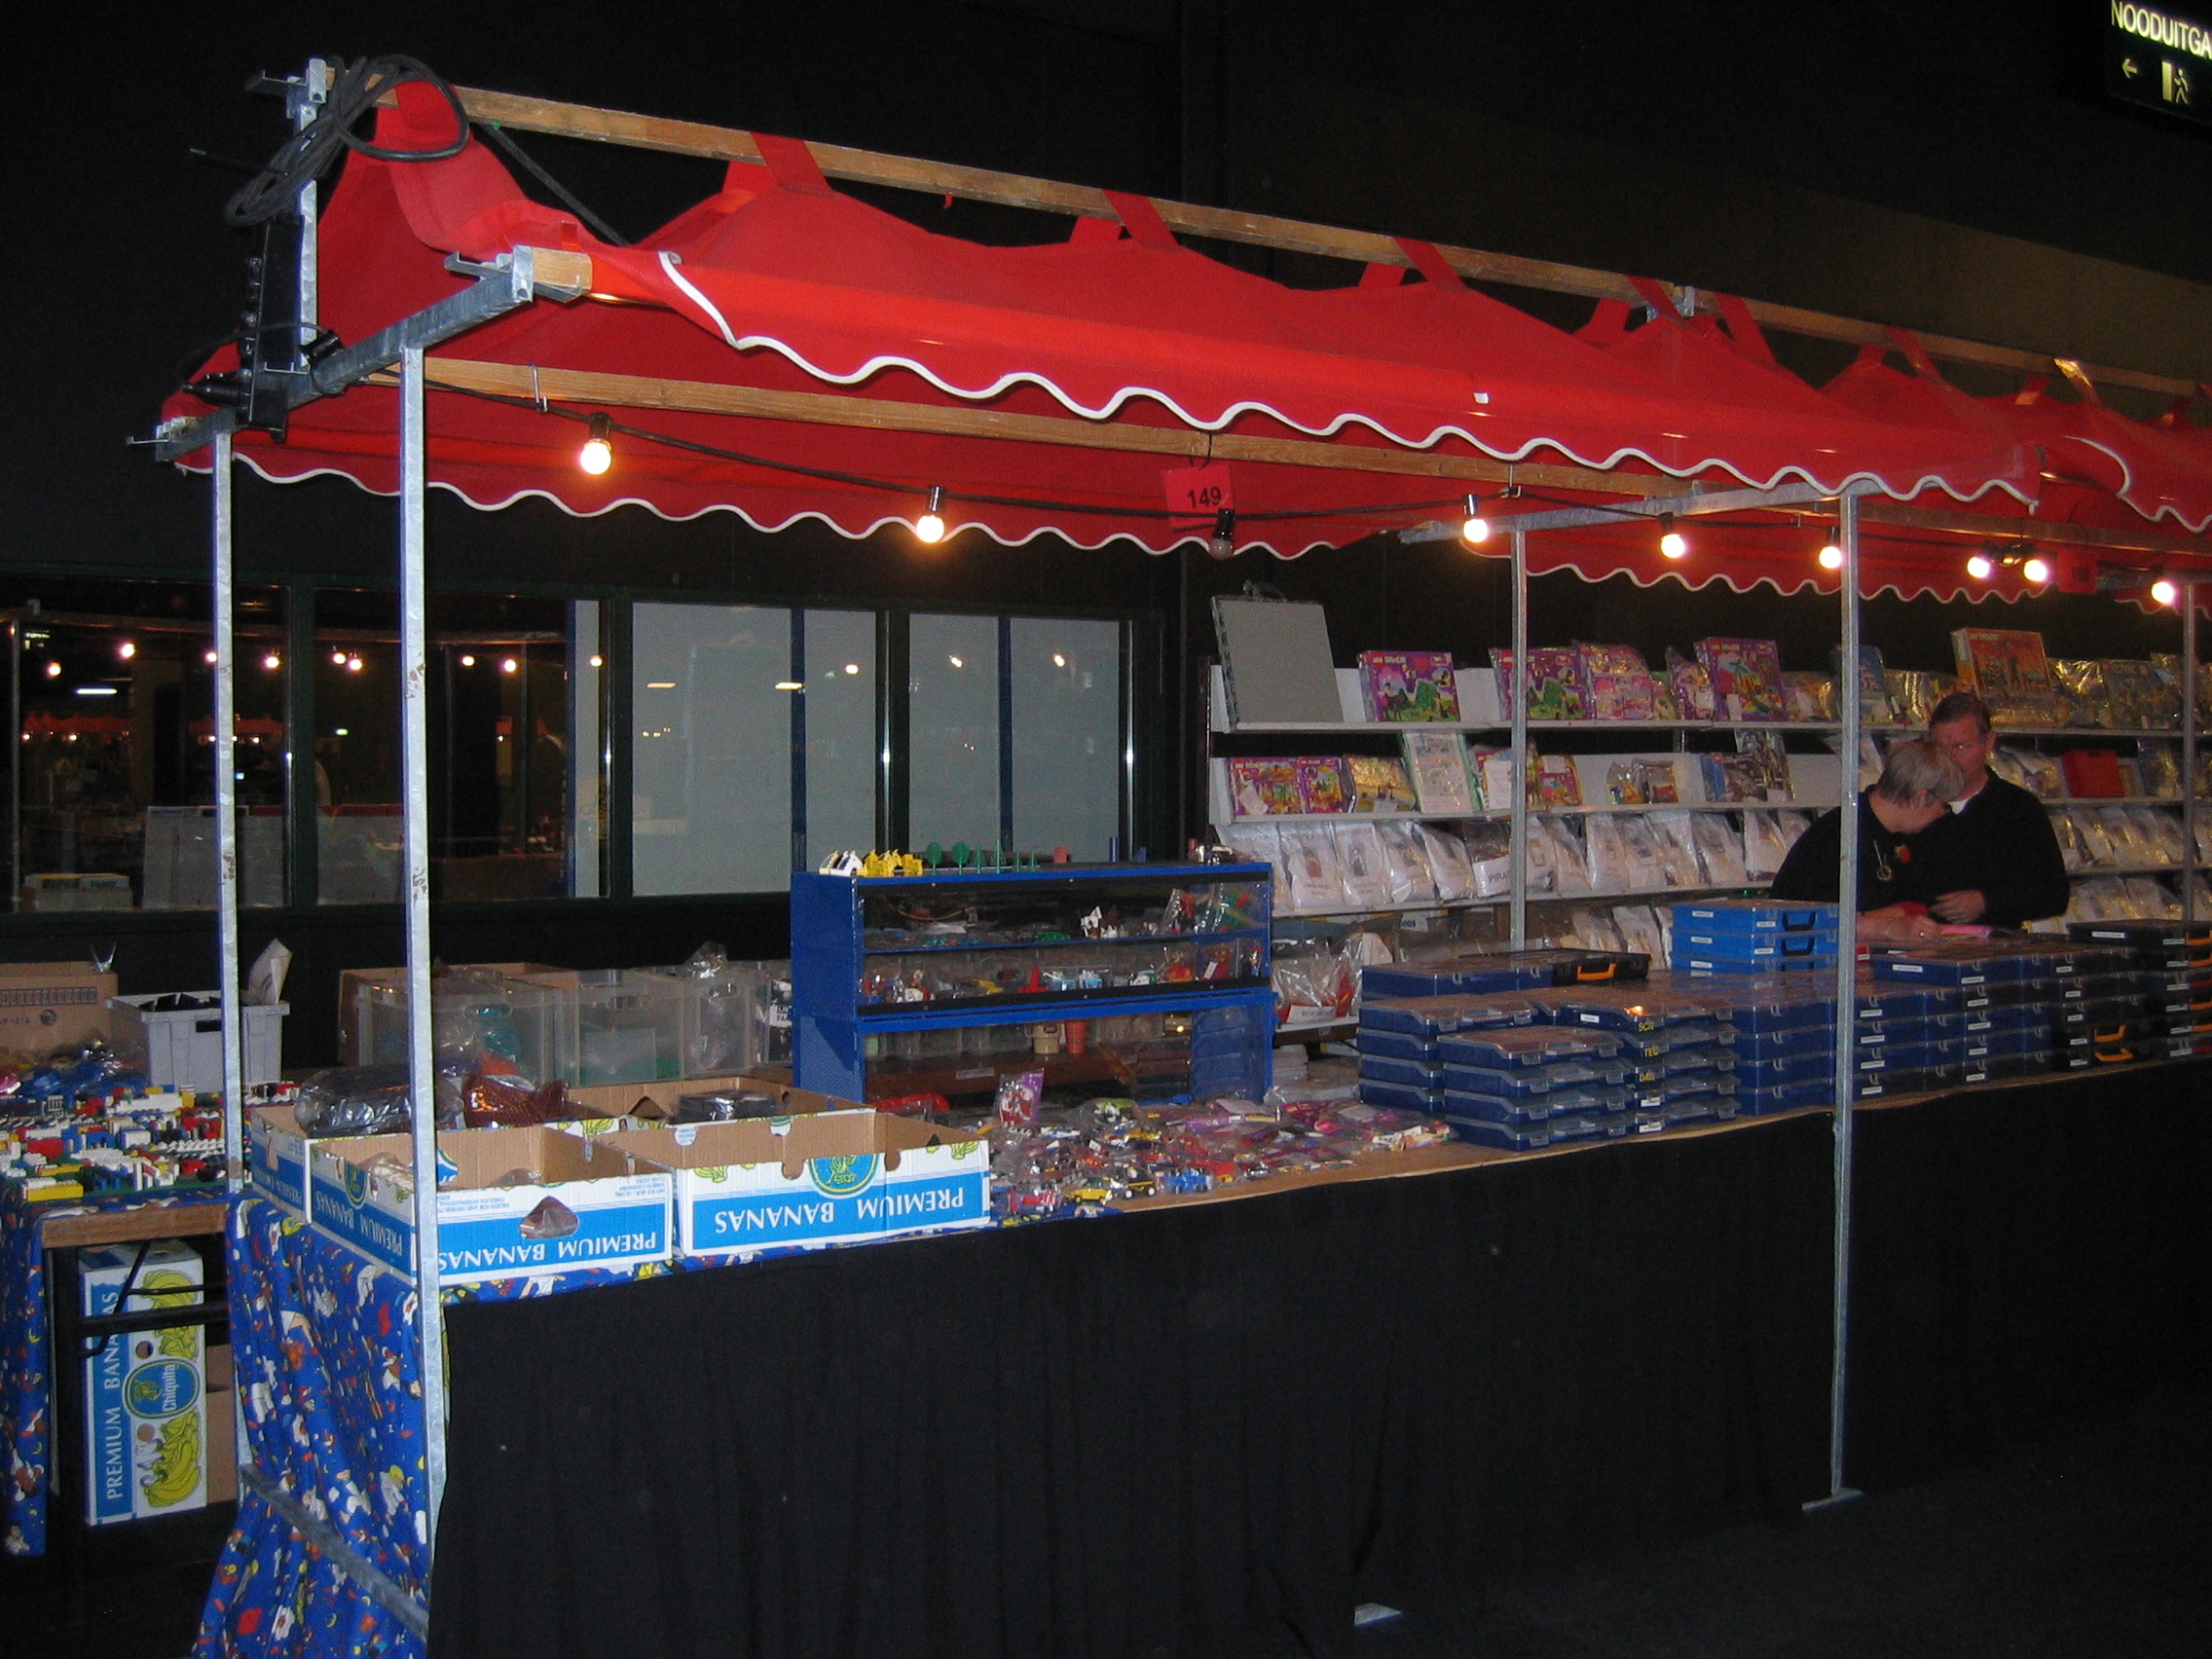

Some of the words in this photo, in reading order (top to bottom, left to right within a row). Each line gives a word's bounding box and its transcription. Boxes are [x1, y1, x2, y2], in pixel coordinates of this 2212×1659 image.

[2111, 0, 2212, 59] NOODUITGA
[1188, 487, 1221, 508] 149
[316, 1191, 354, 1229] BANANAS
[715, 1201, 835, 1234] BANANAS
[857, 1187, 964, 1220] PREMIUM
[360, 1214, 402, 1256] PREMIUM
[558, 1232, 657, 1259] PREMIUM
[438, 1242, 545, 1271] BANANAS
[102, 1291, 122, 1390] BANAAS
[163, 1364, 177, 1412] Chiquita
[105, 1406, 124, 1500] PREMIUM
